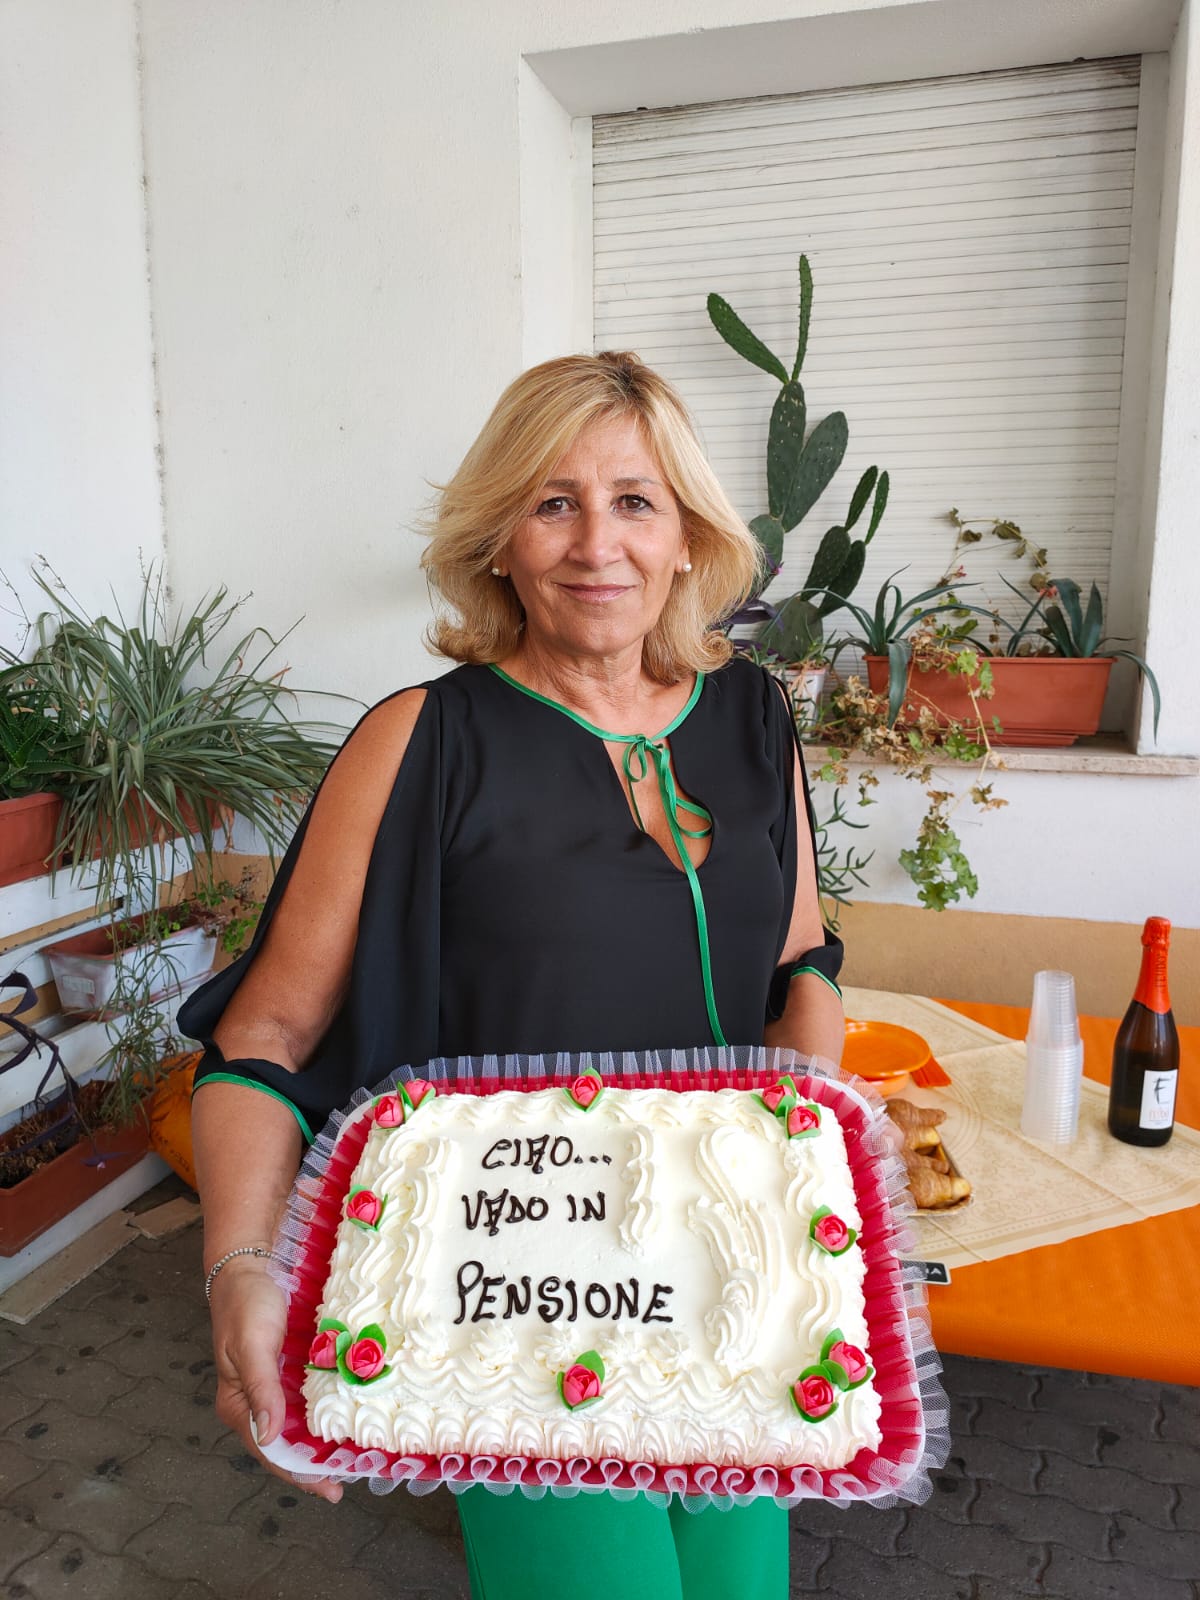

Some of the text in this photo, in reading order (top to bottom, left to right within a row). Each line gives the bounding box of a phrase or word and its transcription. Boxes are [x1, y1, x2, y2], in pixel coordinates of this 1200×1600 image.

[481, 1134, 612, 1174] CIAO...
[461, 1188, 606, 1237] VADO IN
[453, 1260, 674, 1325] PENSIONE
